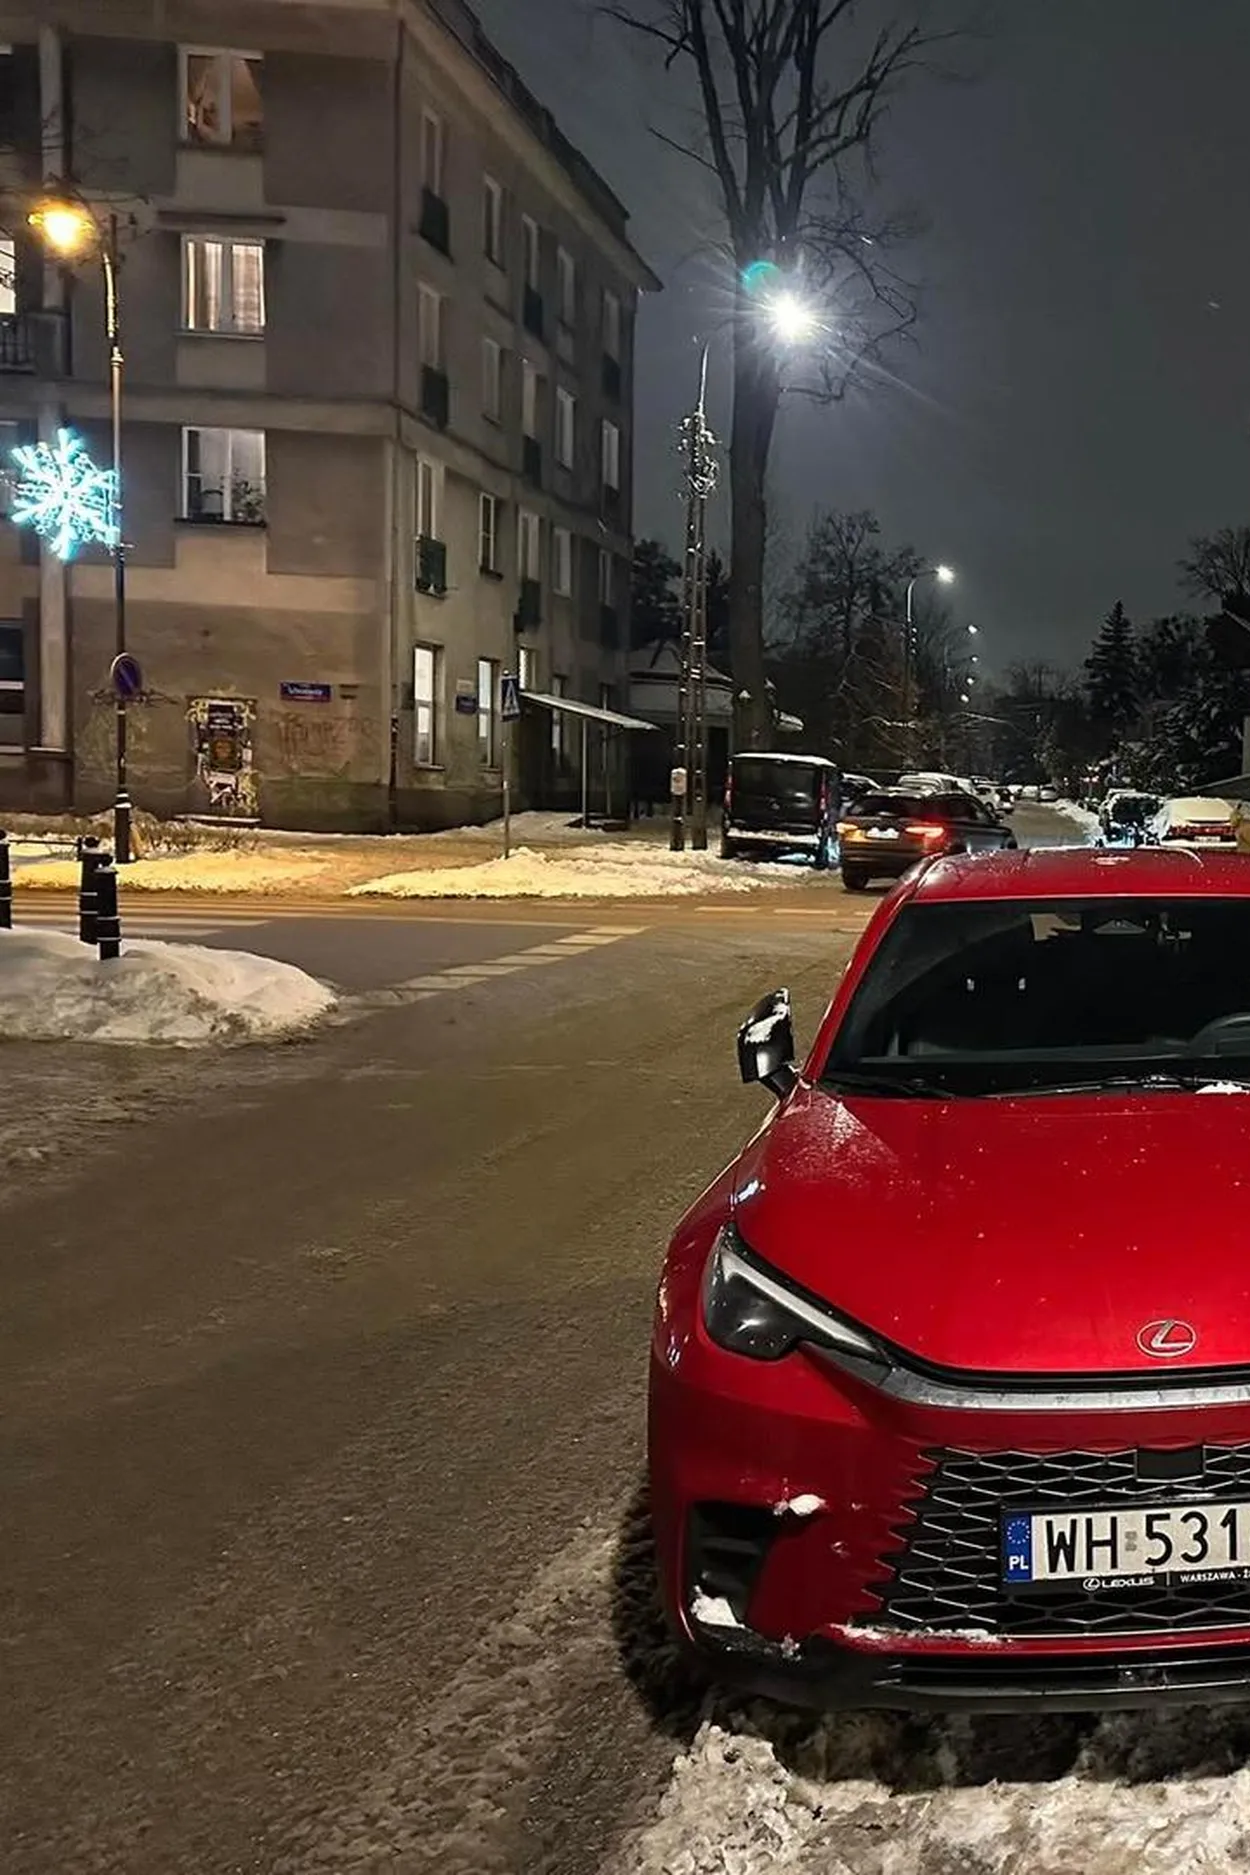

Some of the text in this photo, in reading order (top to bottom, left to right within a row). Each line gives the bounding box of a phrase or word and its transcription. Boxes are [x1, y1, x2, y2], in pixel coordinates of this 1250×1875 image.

[1045, 1516, 1119, 1573] WH
[1008, 1555, 1029, 1571] PL
[1101, 1576, 1155, 1588] LEXUS
[1180, 1570, 1236, 1583] WARSZAWA
